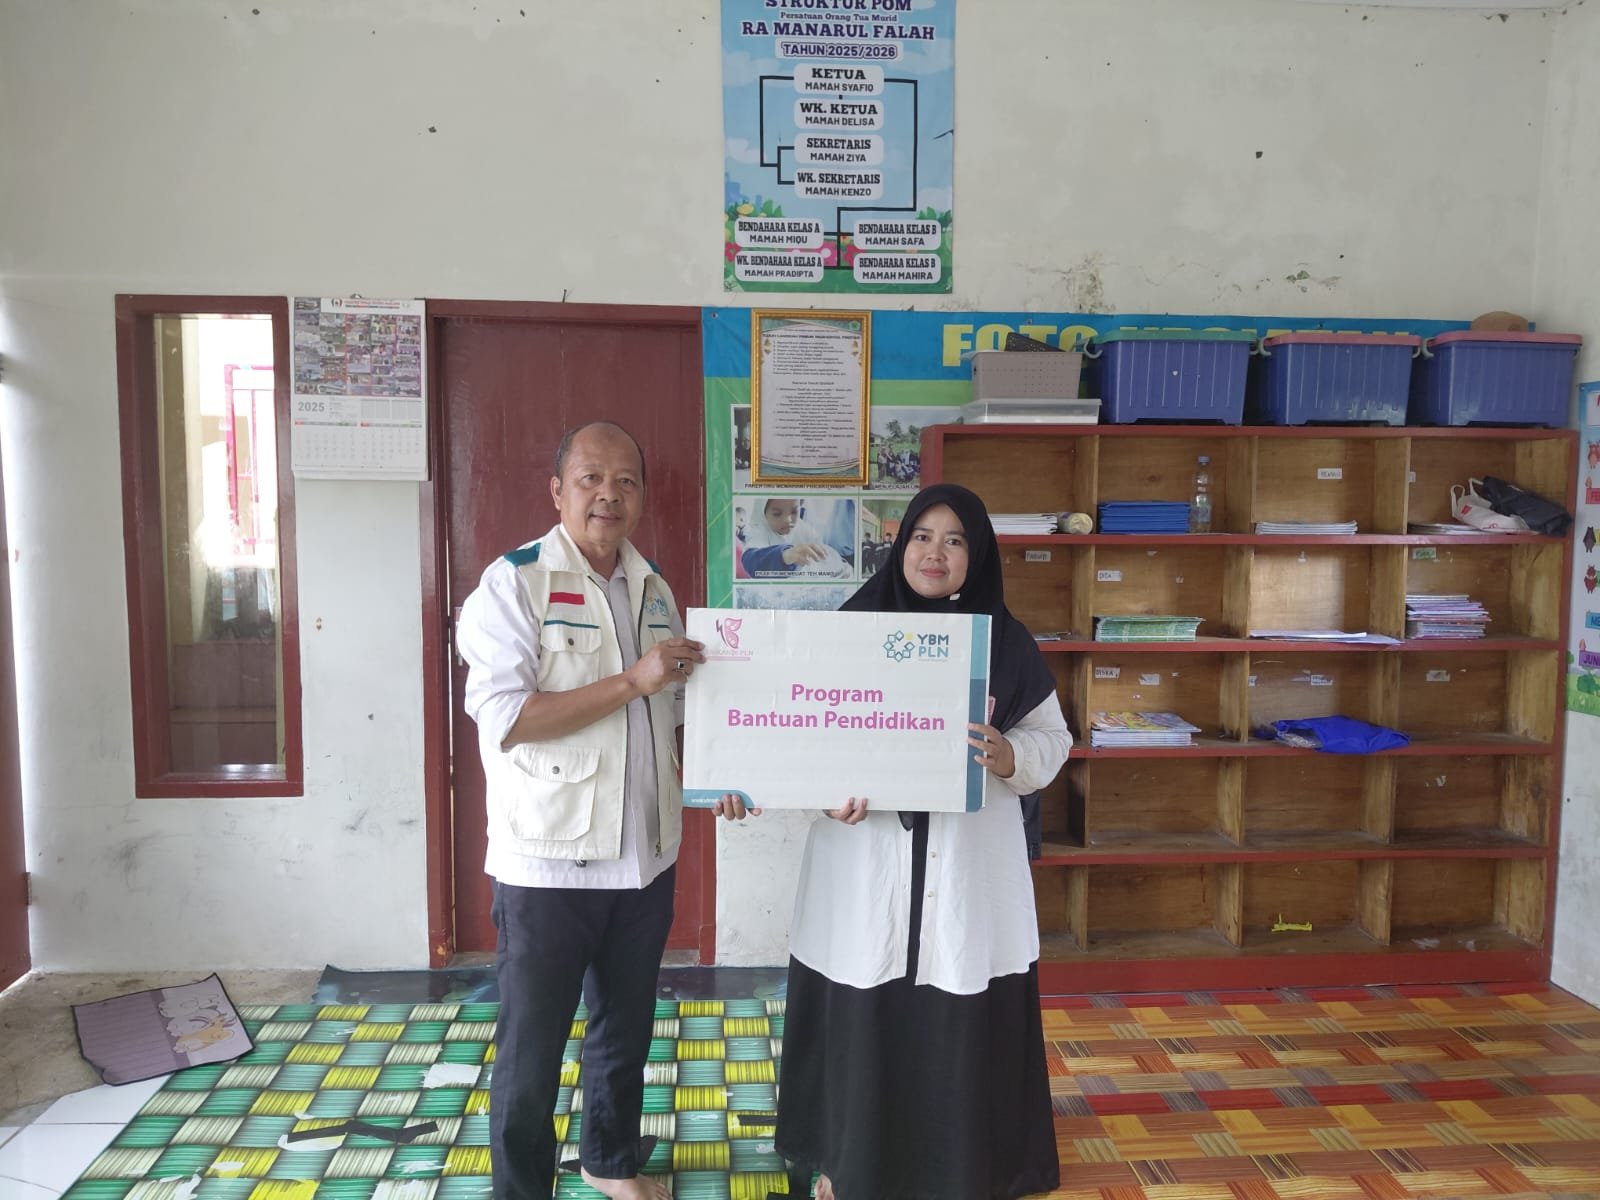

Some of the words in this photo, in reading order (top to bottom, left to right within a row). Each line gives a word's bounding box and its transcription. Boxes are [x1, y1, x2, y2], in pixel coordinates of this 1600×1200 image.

[871, 0, 912, 11] POM
[780, 12, 823, 20] Persatuan
[825, 13, 851, 21] Orang
[871, 14, 897, 22] Murid
[742, 21, 769, 36] RA
[773, 22, 869, 38] MANARUL
[873, 25, 935, 40] FALAH
[783, 43, 826, 56] TAHUN
[828, 44, 896, 58] 2025/2026
[811, 68, 866, 80] KETUA
[805, 81, 840, 91] MAMAH
[800, 102, 827, 114] WK.
[830, 103, 878, 115] KETUA
[805, 115, 840, 125] MAMAH
[841, 117, 875, 126] DELISA
[806, 138, 871, 150] SEKRETARIS
[810, 152, 845, 162] MAMAH
[846, 153, 867, 163] ZIYA
[797, 172, 817, 183] WK.
[818, 173, 881, 185] SEKRETARIS
[805, 186, 840, 195] MAMAH
[841, 187, 872, 197] KENZO
[738, 221, 786, 233] BENDAHARA
[787, 222, 814, 233] KELAS
[814, 223, 821, 234] A
[858, 223, 905, 234] BENDAHARA
[906, 224, 931, 235] KELAS
[931, 225, 937, 235] B
[749, 234, 785, 244] MAMAH
[785, 235, 808, 245] MIQU
[865, 237, 900, 246] MAMAH
[901, 238, 925, 246] SAFA
[736, 256, 750, 266] WK.
[750, 256, 793, 266] BENDAHARA
[794, 256, 816, 267] KELAS
[816, 257, 822, 268] A
[859, 257, 905, 268] BENDAHARA
[905, 258, 930, 269] KELAS
[930, 258, 936, 268] B
[744, 269, 775, 278] MAMAH
[775, 270, 814, 279] PRADIPTA
[862, 271, 897, 280] MAMAH
[898, 272, 934, 281] MAHIRA
[298, 401, 325, 412] 2025
[917, 633, 950, 646] YBM
[918, 646, 950, 658] PLN
[1583, 652, 1600, 666] JUN
[791, 683, 884, 706] Program
[727, 709, 818, 728] Bantuan
[824, 710, 945, 731] Pendidikan
